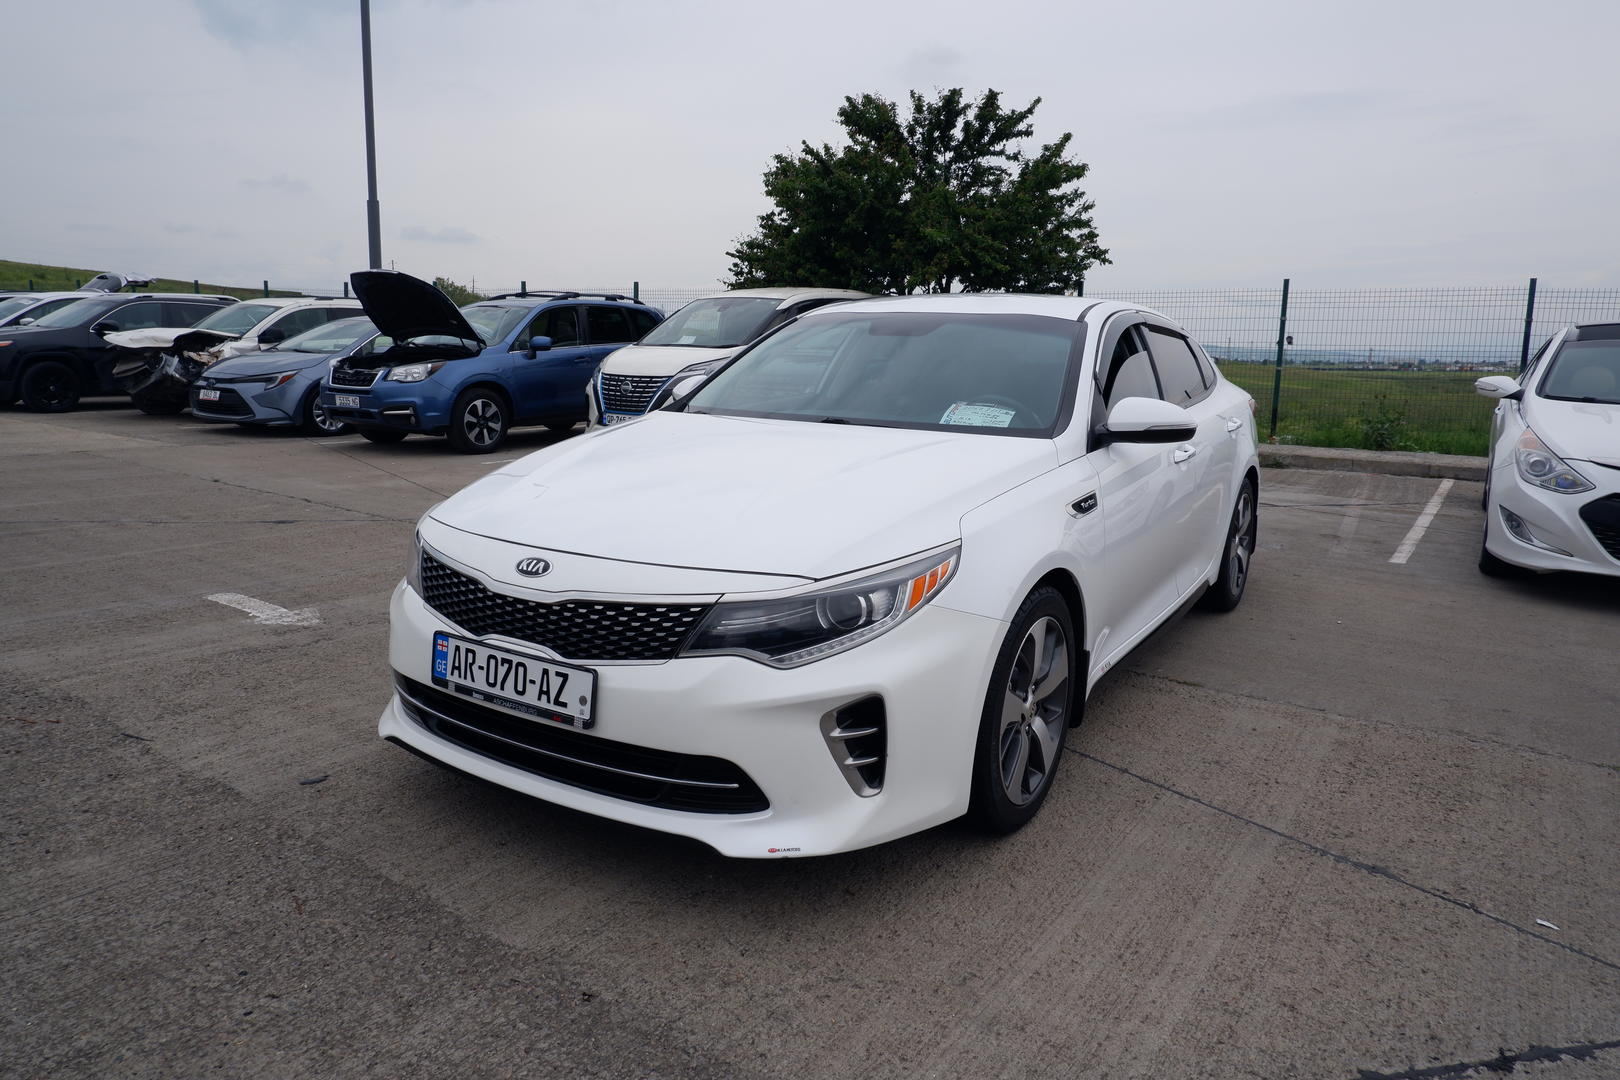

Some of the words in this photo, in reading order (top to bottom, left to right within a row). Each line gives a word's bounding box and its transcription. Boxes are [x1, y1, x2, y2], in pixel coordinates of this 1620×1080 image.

[518, 559, 545, 574] KIA
[436, 659, 447, 673] GE
[450, 645, 569, 709] AR-070-AZ
[493, 698, 538, 716] ASCHAFFENBURG
